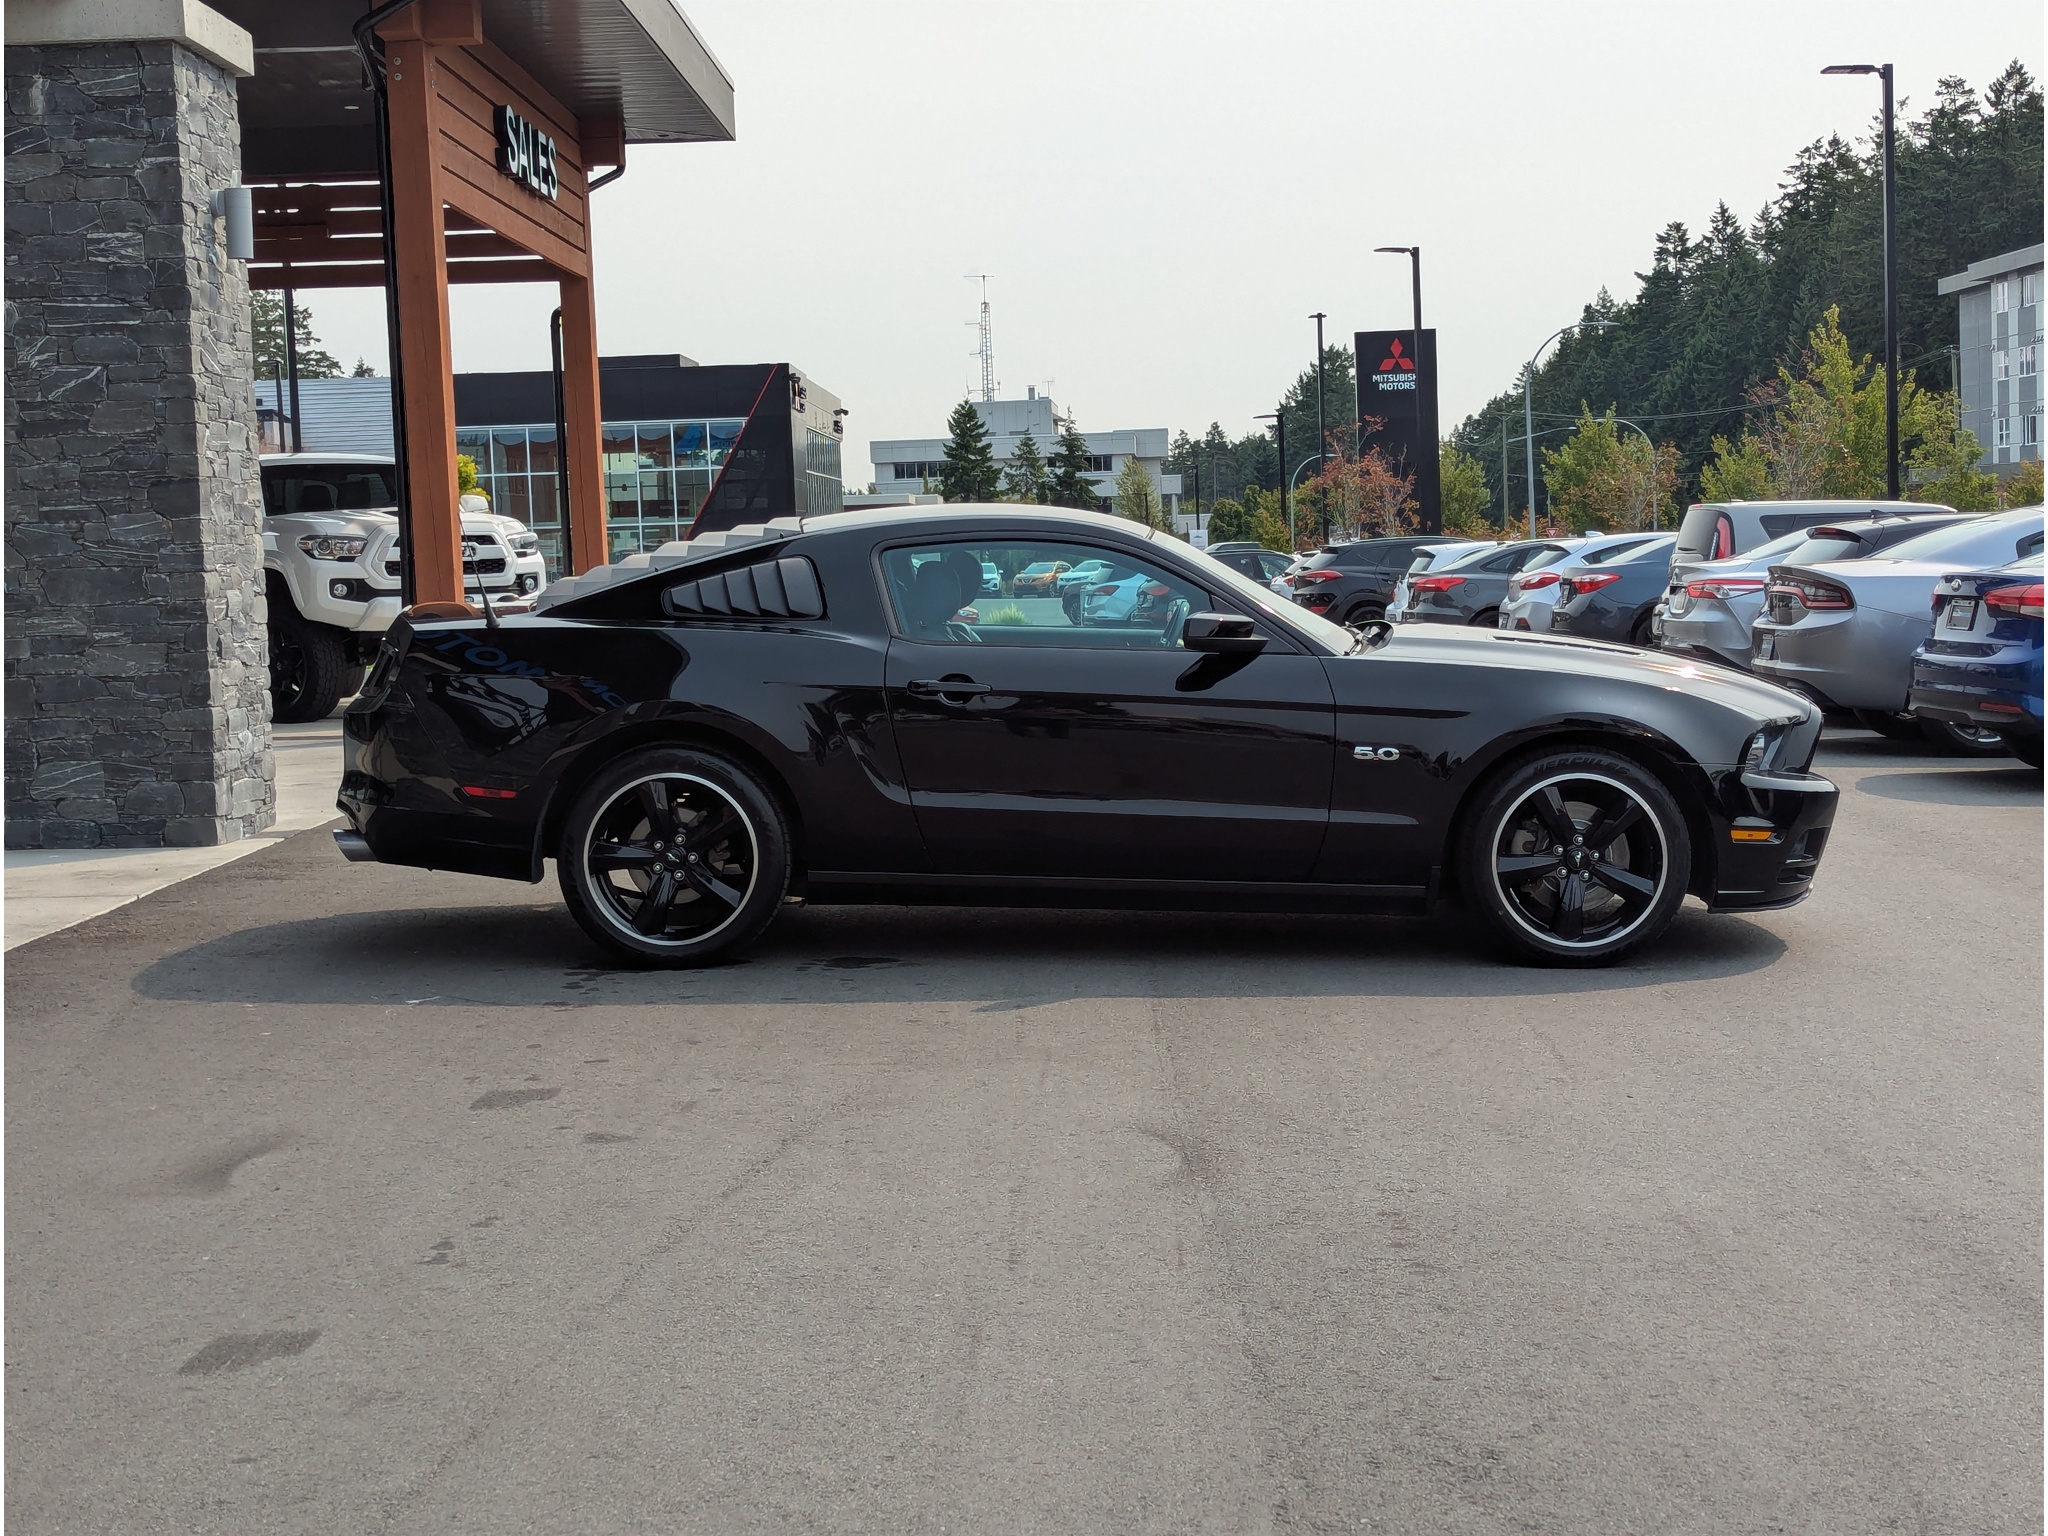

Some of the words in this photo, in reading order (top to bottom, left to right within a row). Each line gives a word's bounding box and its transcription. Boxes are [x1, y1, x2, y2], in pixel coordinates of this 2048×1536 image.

[506, 104, 558, 201] SALES
[1378, 382, 1416, 391] MOTORS
[1353, 746, 1400, 761] 5.0
